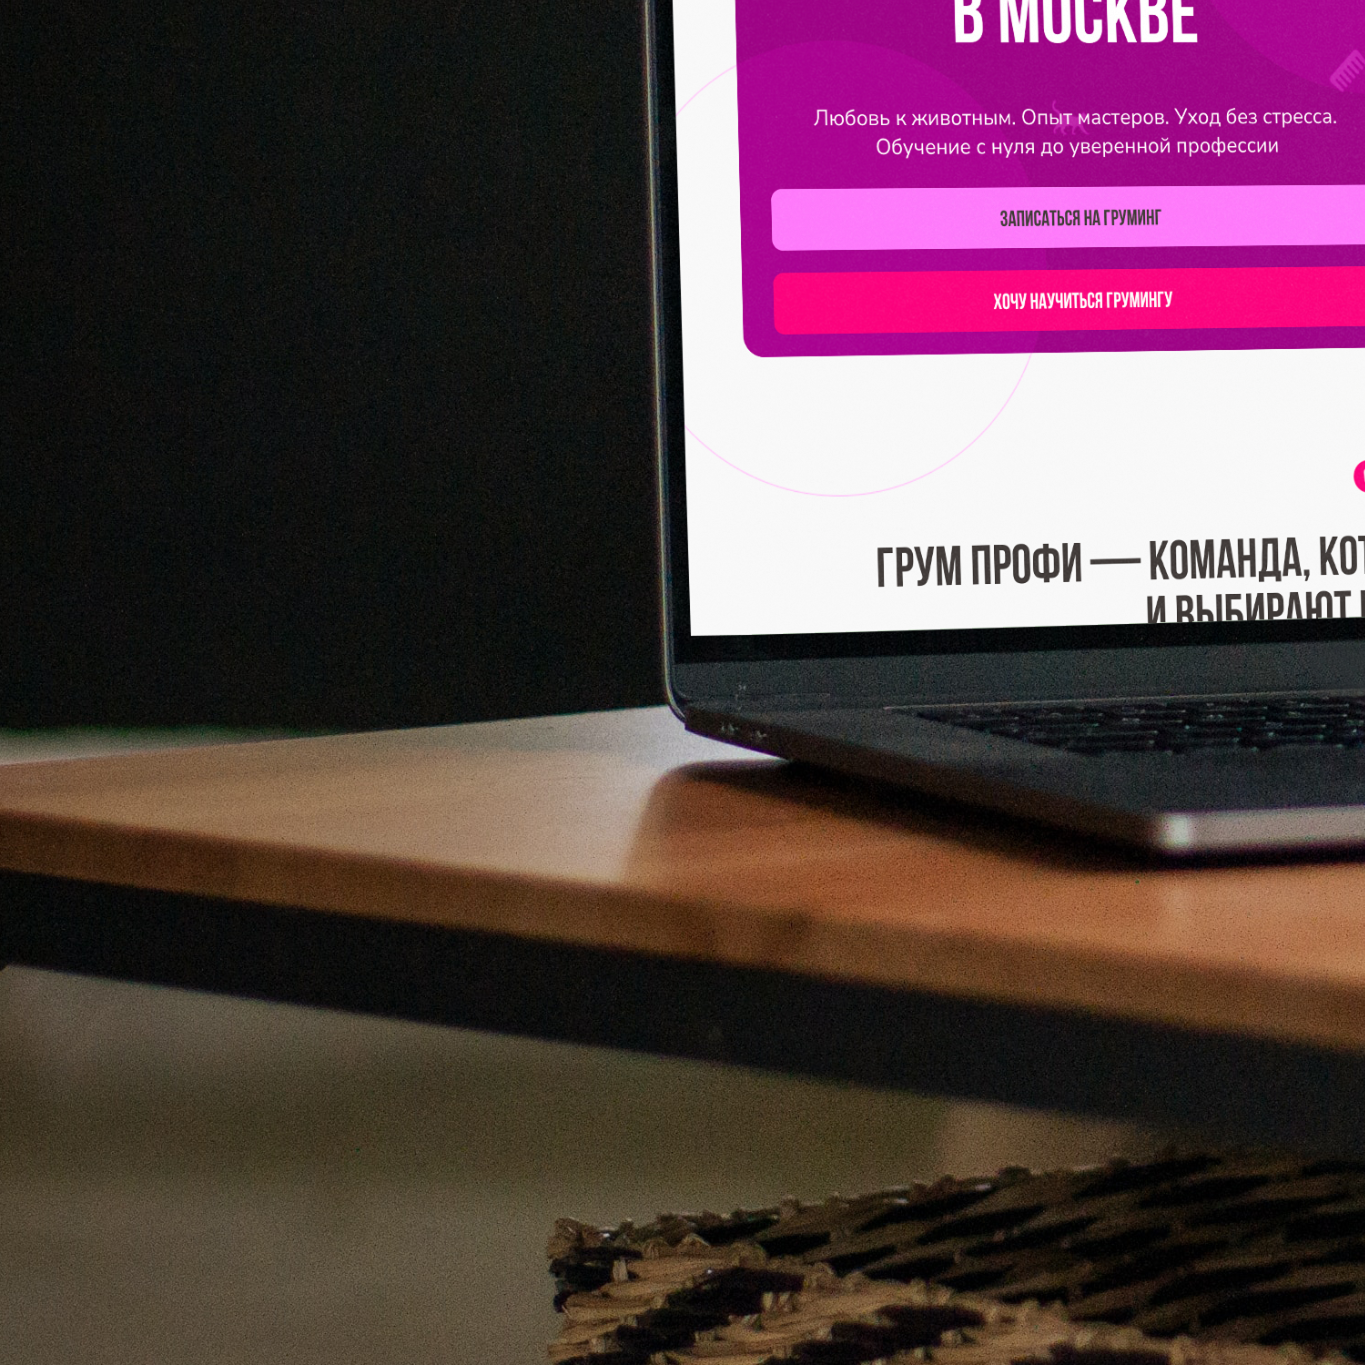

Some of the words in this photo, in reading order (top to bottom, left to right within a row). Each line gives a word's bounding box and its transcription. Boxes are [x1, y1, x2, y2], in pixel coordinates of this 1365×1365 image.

[813, 108, 891, 127] Любовь
[896, 113, 907, 126] к
[911, 113, 1015, 126] животным.
[1021, 108, 1073, 126] Опыт
[1077, 112, 1169, 129] мастеров.
[1174, 107, 1222, 128] Уход
[1226, 107, 1258, 125] без
[1262, 111, 1337, 129] стресса.
[876, 137, 971, 159] Обучение
[976, 141, 986, 155] с
[991, 141, 1035, 159] нуля
[1040, 141, 1064, 157] до
[1069, 137, 1171, 158] уверенной
[1176, 136, 1279, 158] профессии
[1000, 209, 1081, 226] ЗАПИСАТЬСЯ
[1084, 210, 1101, 225] НА
[1103, 208, 1162, 226] ГРУМИНГ
[993, 292, 1028, 310] ХОЧУ
[1029, 291, 1103, 310] НАУЧИТЬСЯ
[1106, 290, 1173, 309] ГРУМИНГУ
[876, 545, 962, 588] ГРУМ
[971, 542, 1082, 586] ПРОФИ
[1149, 536, 1311, 583] КОМАНДА,
